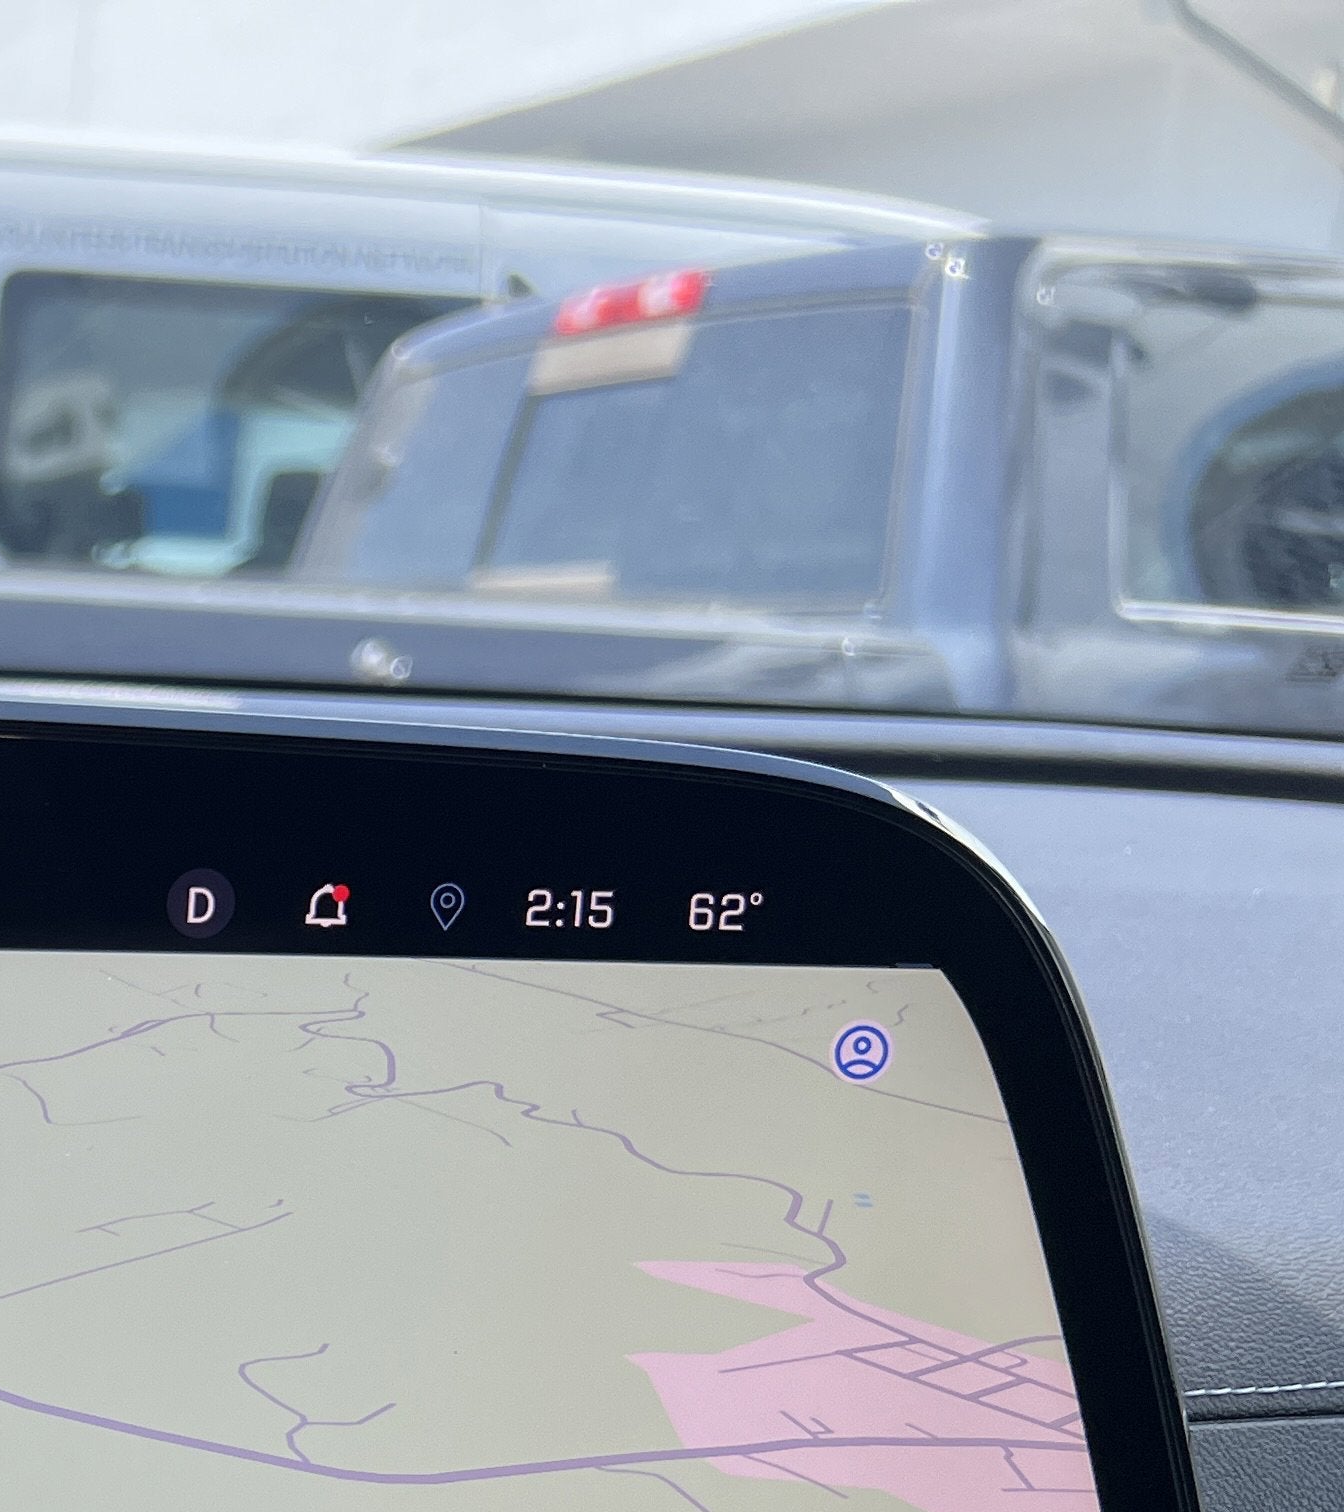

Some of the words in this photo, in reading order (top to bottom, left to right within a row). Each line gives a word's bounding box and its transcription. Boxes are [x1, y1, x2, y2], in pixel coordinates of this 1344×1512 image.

[186, 886, 215, 924] D
[525, 888, 614, 929] 2:15
[688, 890, 764, 931] 62°
